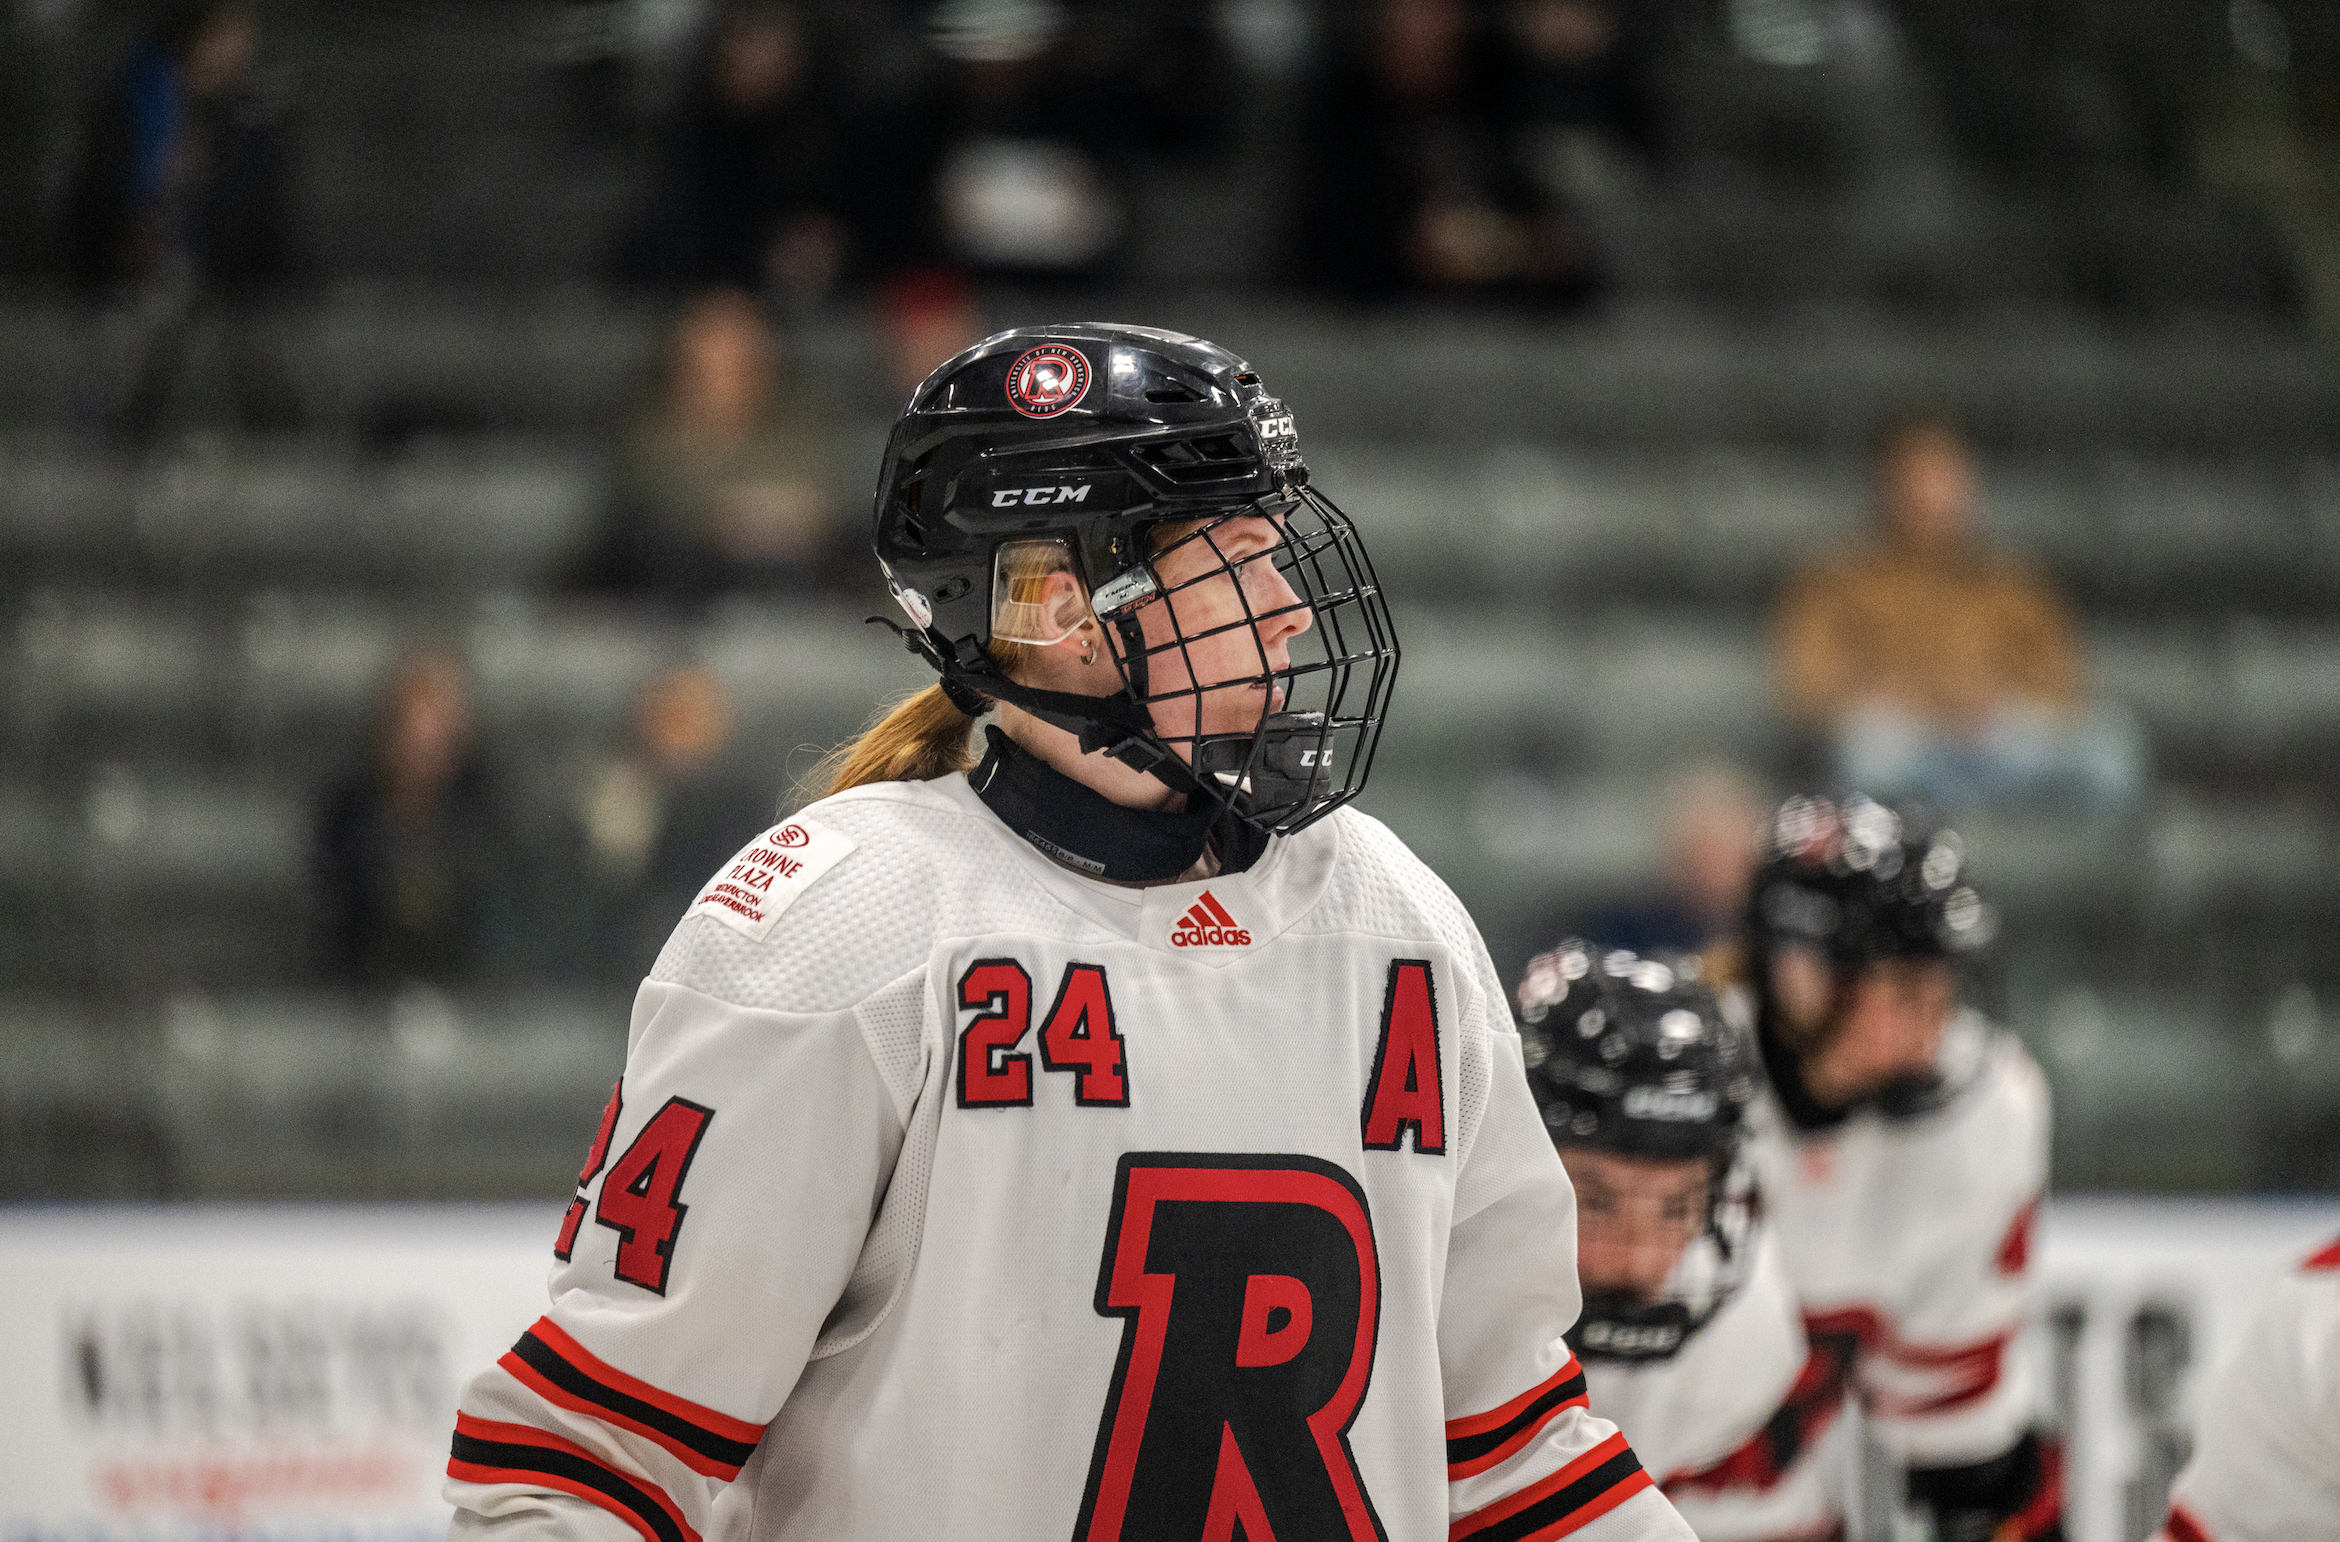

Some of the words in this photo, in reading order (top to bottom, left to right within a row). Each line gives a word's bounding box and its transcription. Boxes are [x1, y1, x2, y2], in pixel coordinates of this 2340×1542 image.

[1035, 348, 1045, 356] OF
[1051, 348, 1068, 357] NEW
[991, 484, 1092, 508] CCM
[726, 865, 774, 892] PLAZA
[1171, 926, 1252, 947] adidas
[957, 957, 1131, 1109] 24
[1360, 958, 1446, 1156] A
[1071, 1151, 1390, 1542] R
